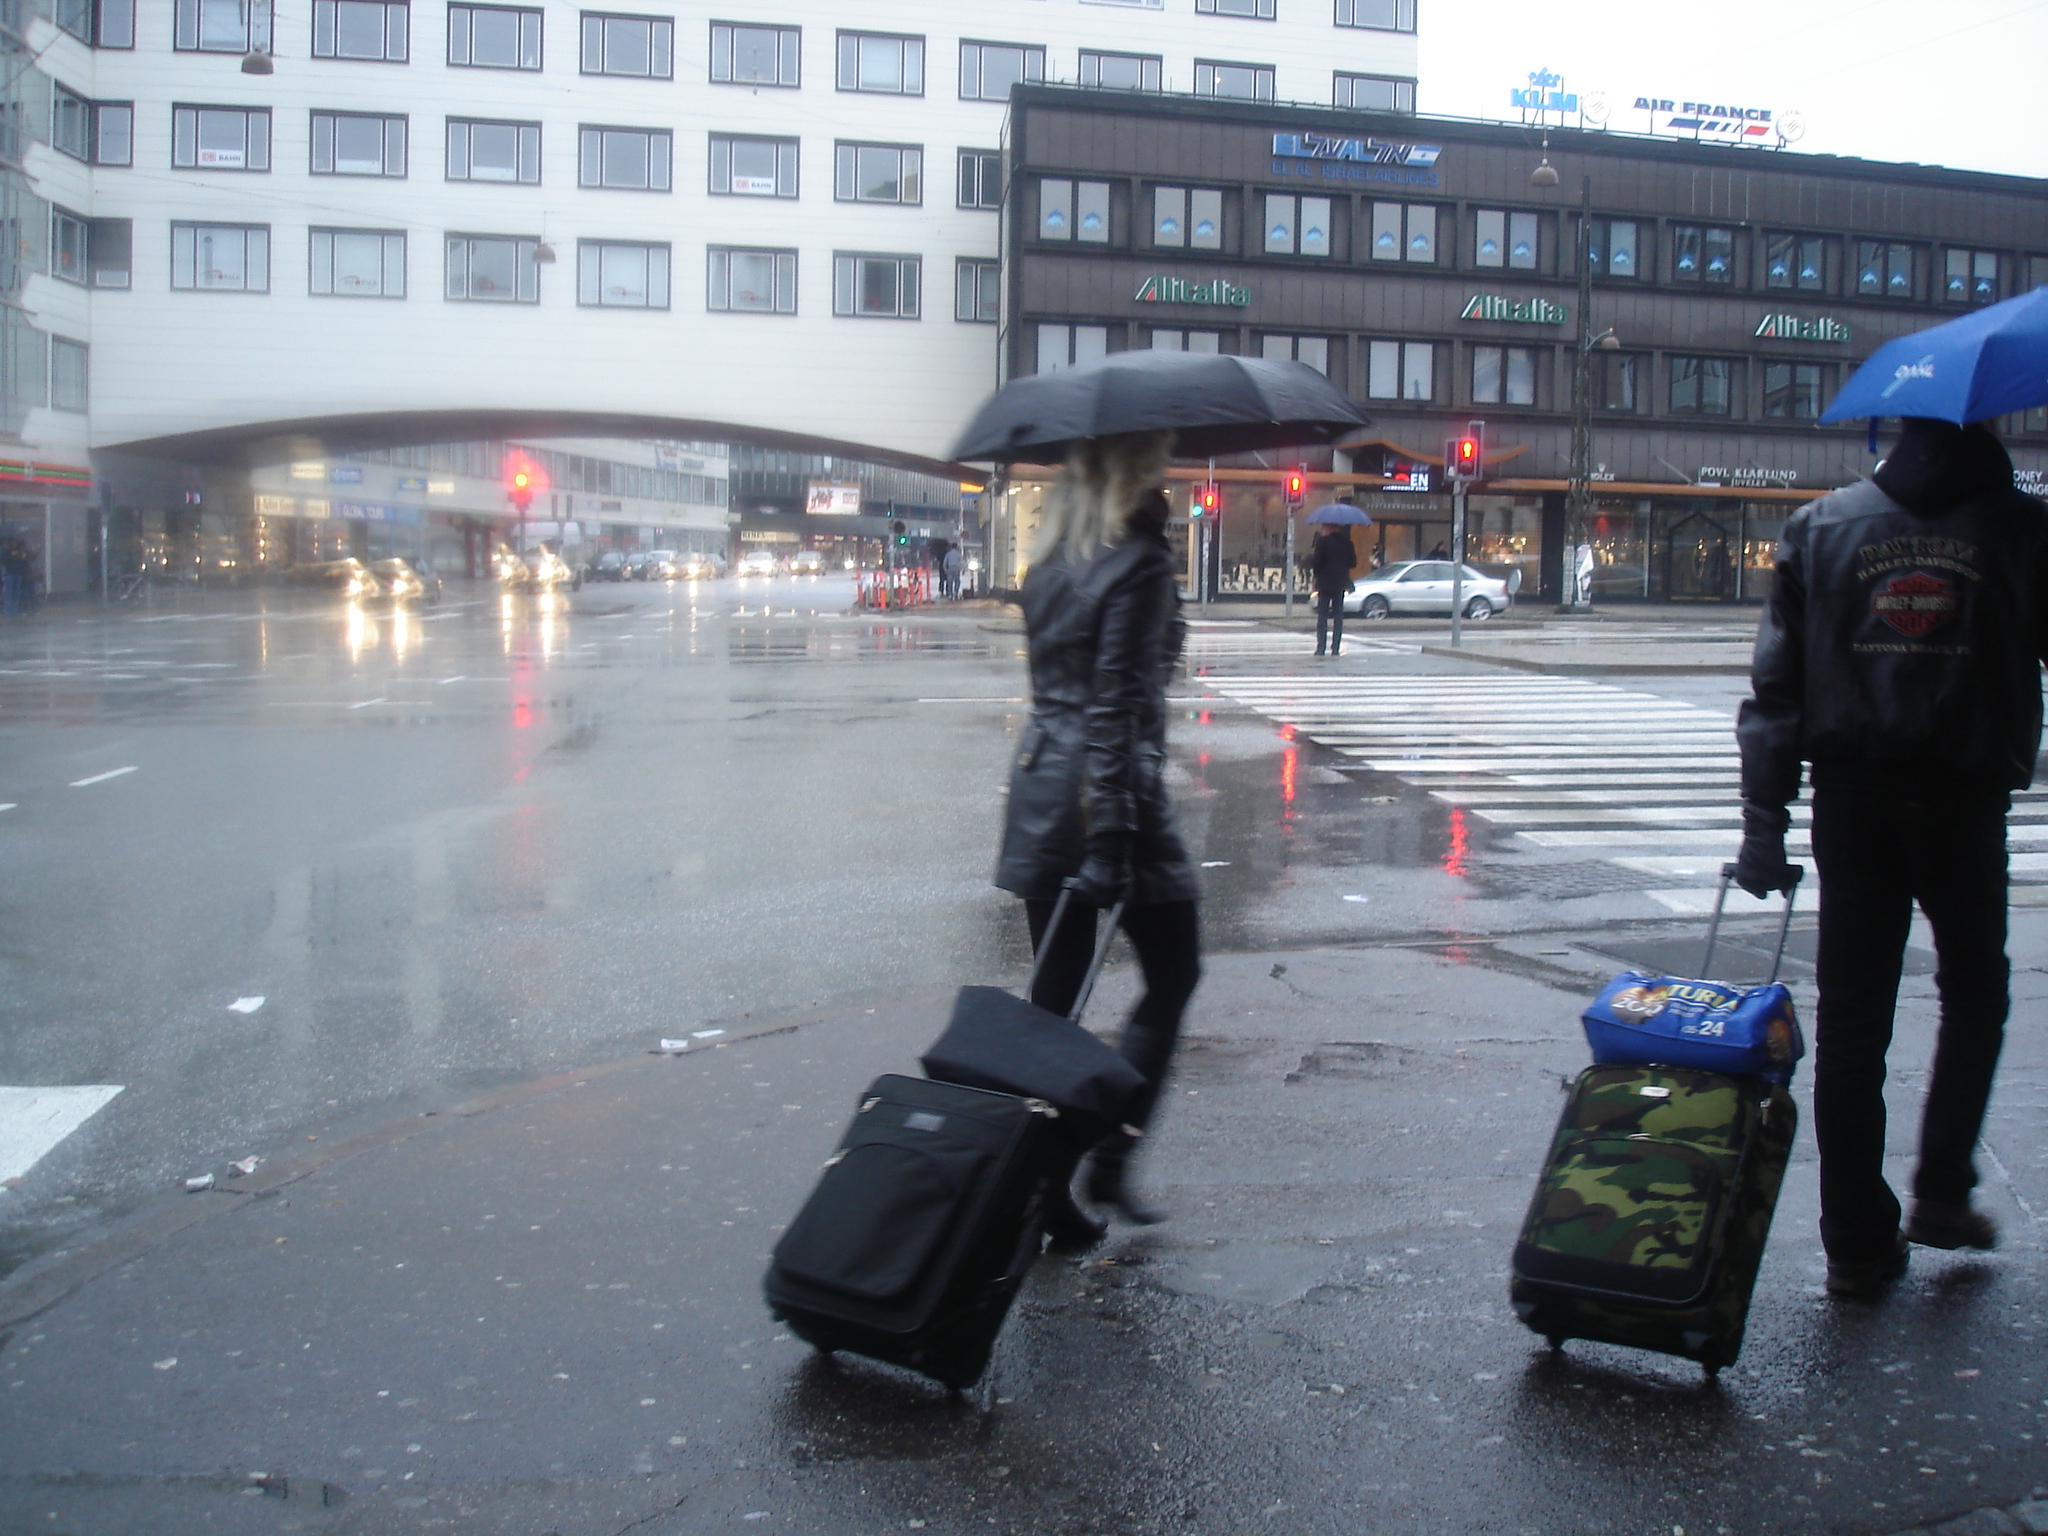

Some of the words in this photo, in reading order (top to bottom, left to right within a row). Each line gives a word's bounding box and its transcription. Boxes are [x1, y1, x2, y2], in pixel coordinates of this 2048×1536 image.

[1510, 88, 1577, 112] KLM
[1633, 97, 1675, 112] AIR
[1682, 102, 1772, 122] FRANCE
[1272, 160, 1292, 175] EL
[1295, 163, 1313, 177] AL
[1321, 165, 1375, 181] ISRAEL
[1375, 168, 1439, 186] AIRLINES
[1135, 276, 1251, 306] Alitalia
[1460, 295, 1567, 323] Alitalia
[1755, 314, 1852, 342] Alitalia
[1735, 468, 1797, 480] KLARLUND
[2013, 470, 2043, 482] ONEY
[2014, 482, 2048, 496] ANGE
